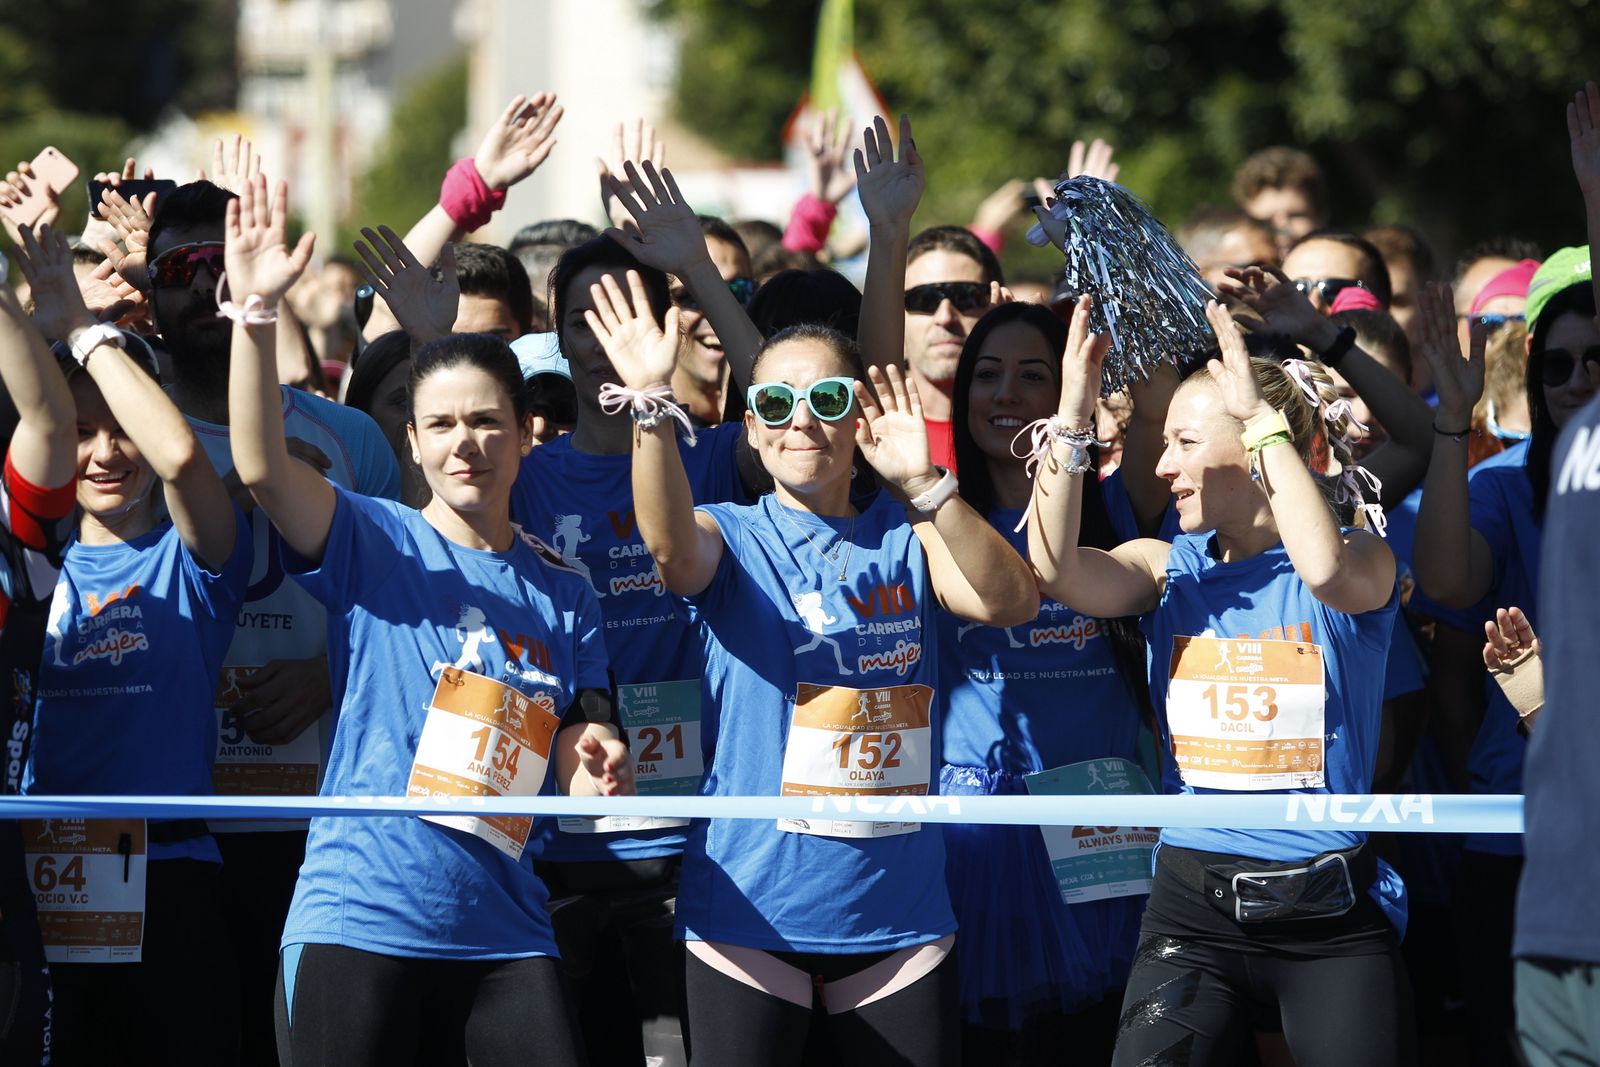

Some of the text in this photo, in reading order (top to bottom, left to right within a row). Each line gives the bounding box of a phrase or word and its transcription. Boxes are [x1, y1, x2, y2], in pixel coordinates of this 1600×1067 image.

[855, 615, 922, 636] CARRERA
[73, 628, 147, 666] mujer
[1236, 642, 1262, 655] VIII
[858, 640, 922, 675] mujer
[1039, 669, 1085, 679] NUESTRA
[1087, 666, 1115, 676] META
[125, 684, 153, 694] META
[632, 686, 657, 698] VIII
[874, 690, 891, 703] VIII
[1202, 683, 1279, 722] 153
[1220, 721, 1255, 733] DACIL
[219, 746, 273, 757] ANTONIO
[625, 724, 685, 762] 21
[832, 732, 903, 770] 152
[470, 726, 522, 781] 154
[1103, 760, 1125, 771] VIII
[467, 760, 491, 779] ANA
[492, 769, 512, 791] PEREZ
[849, 770, 885, 781] OLAYA
[1285, 794, 1435, 824] NEXA
[1078, 834, 1121, 849] ALWAYS
[33, 856, 86, 892] 64
